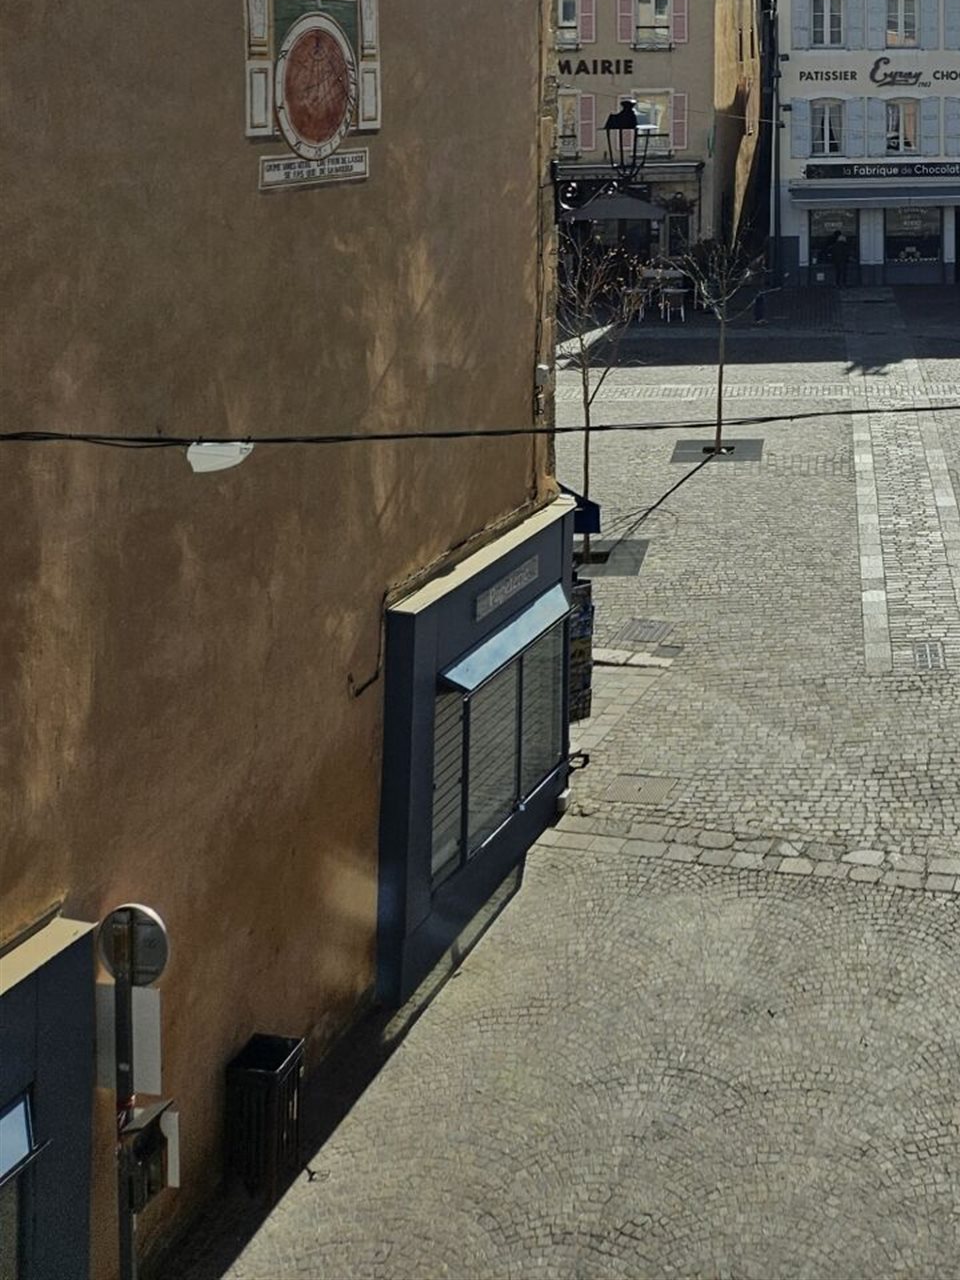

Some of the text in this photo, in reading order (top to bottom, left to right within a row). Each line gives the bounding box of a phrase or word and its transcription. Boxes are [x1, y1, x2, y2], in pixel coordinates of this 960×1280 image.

[558, 59, 633, 75] MAIRIE
[799, 70, 857, 81] PATISSIER
[843, 164, 960, 178] la Fabrique de Chocolat
